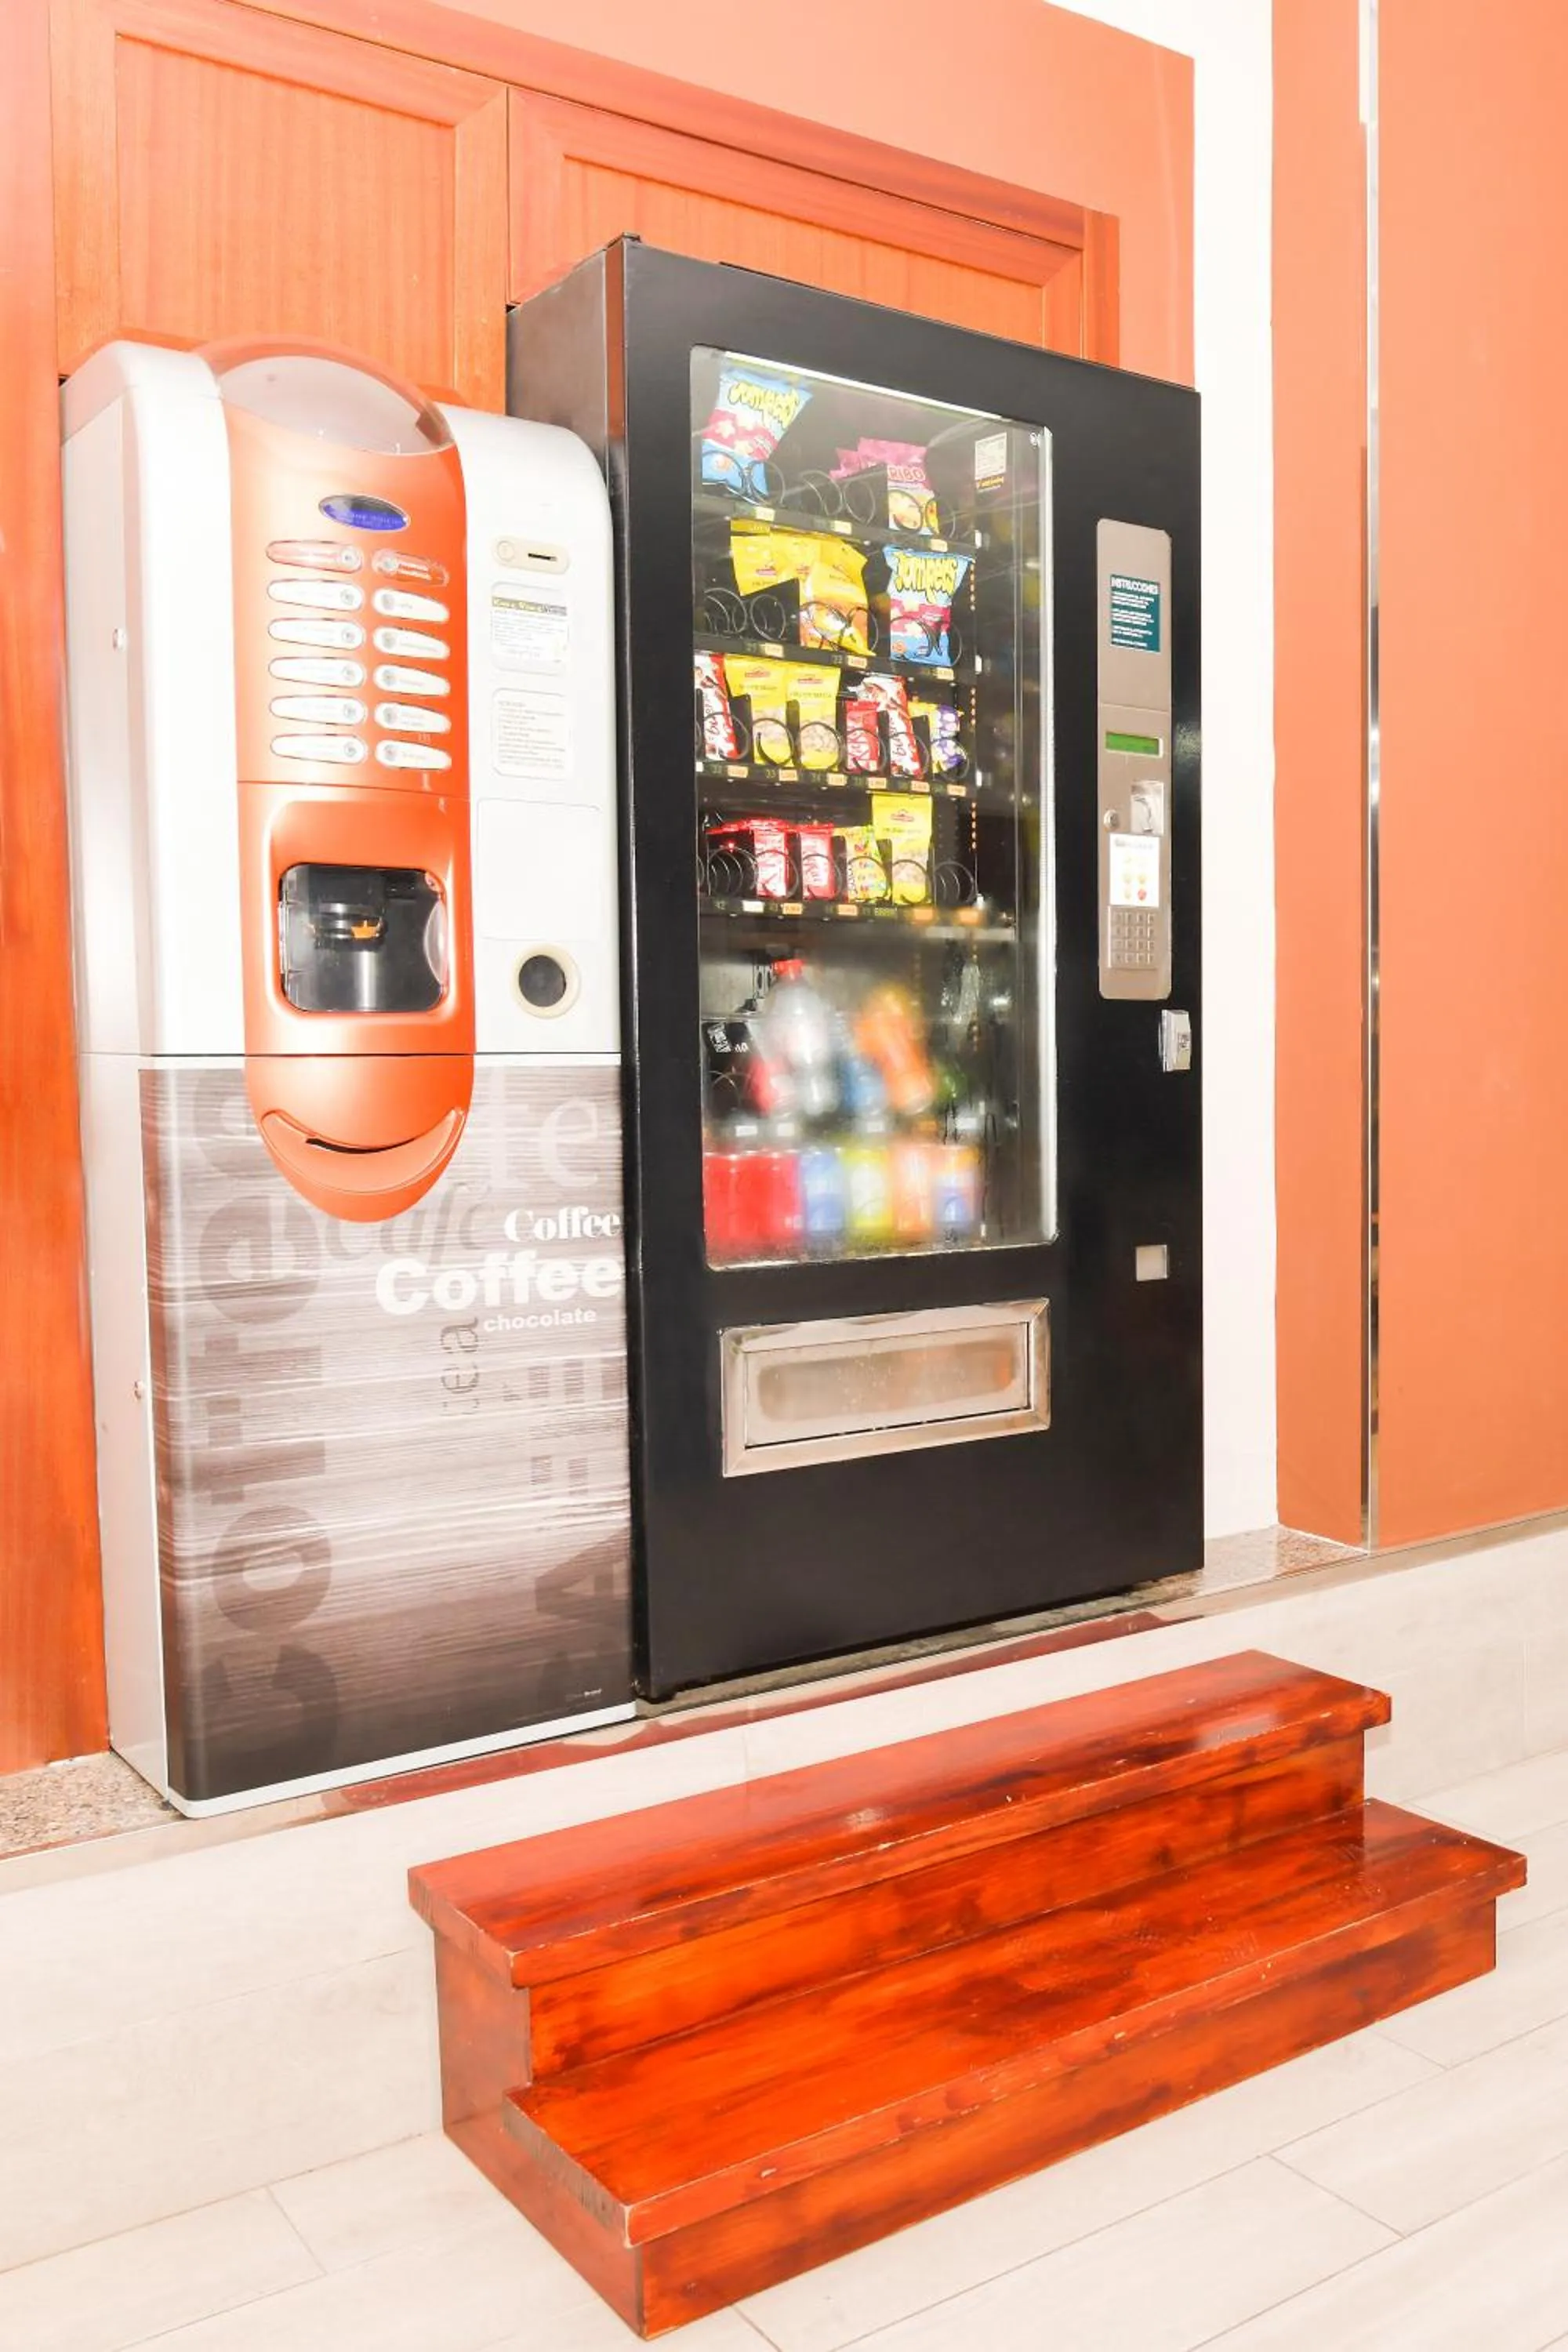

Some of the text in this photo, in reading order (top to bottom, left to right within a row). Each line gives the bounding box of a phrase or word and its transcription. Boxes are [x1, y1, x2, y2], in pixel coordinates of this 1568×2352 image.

[504, 1206, 621, 1243] Coffee
[376, 1250, 622, 1316] Coffee
[483, 1308, 597, 1332] chocolate
